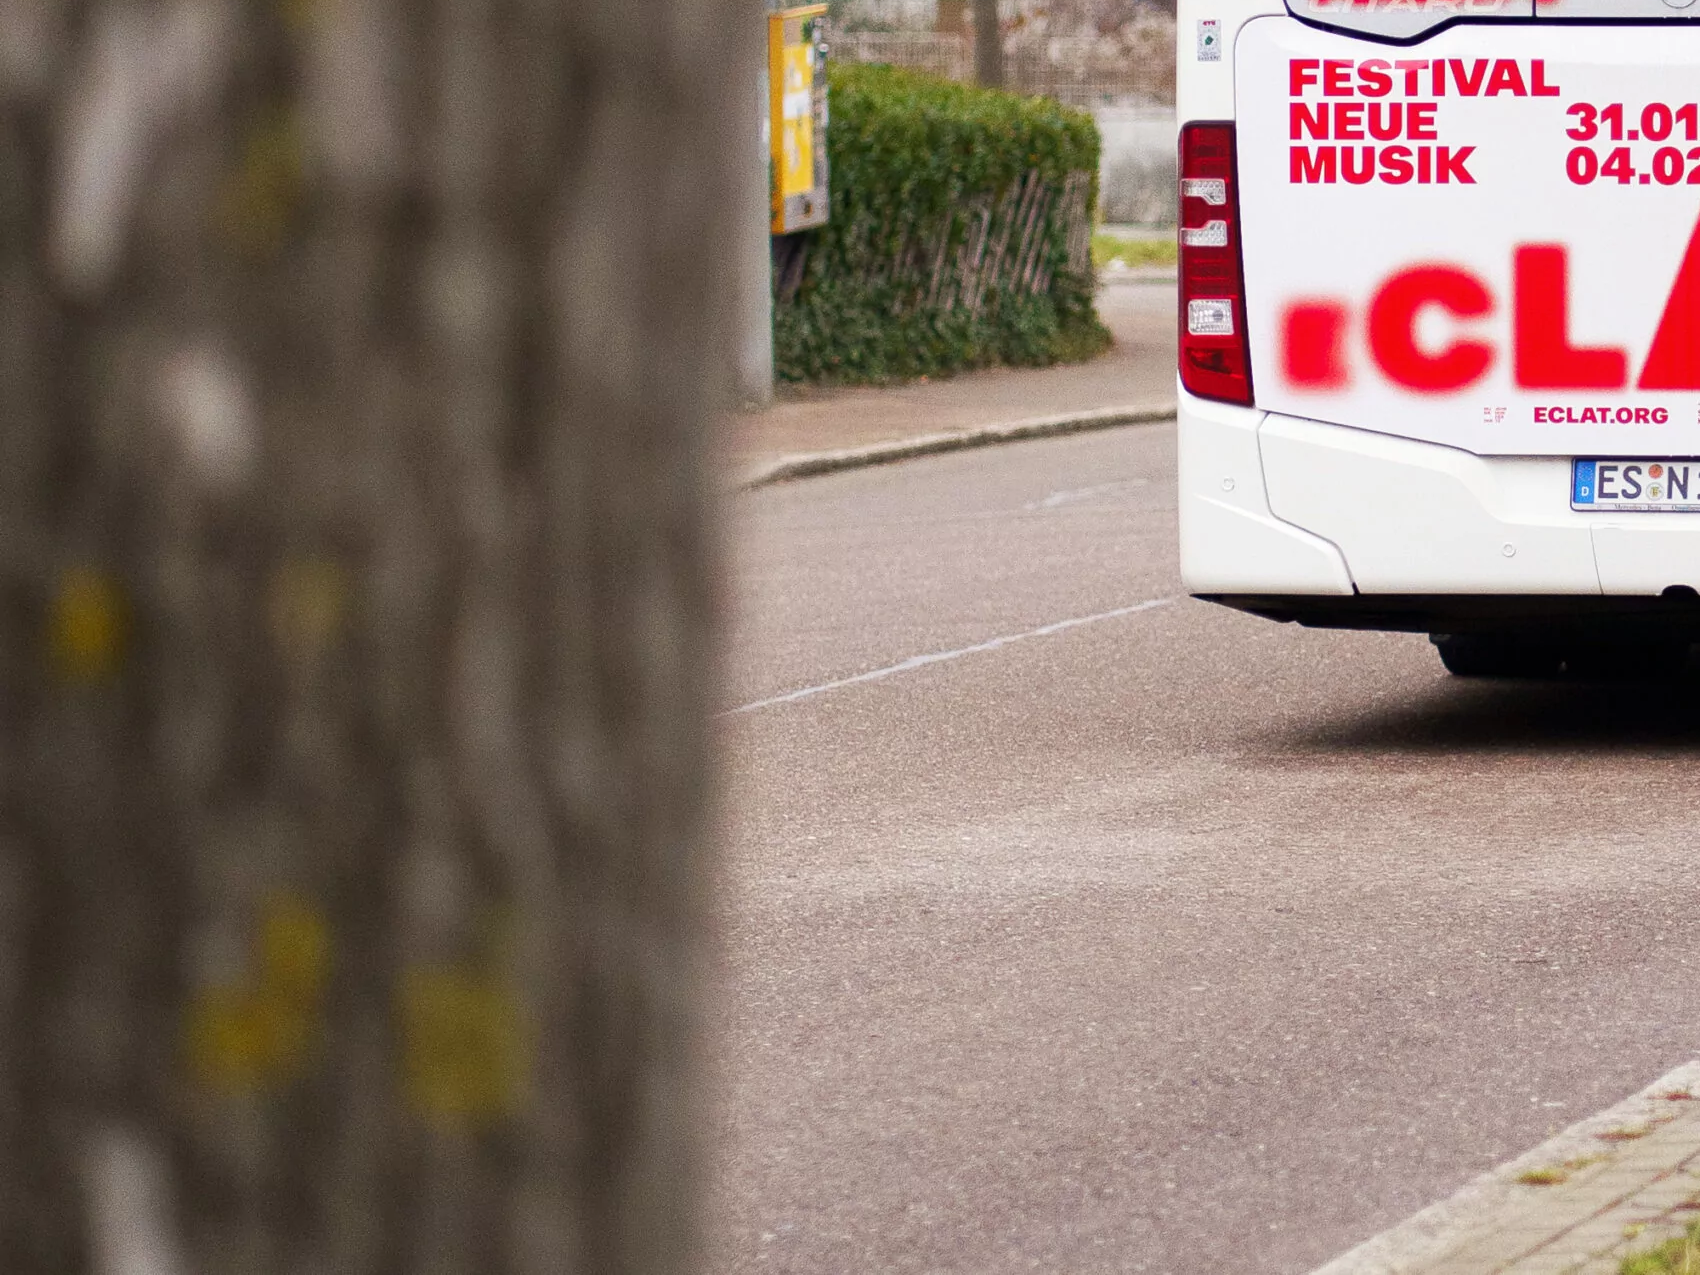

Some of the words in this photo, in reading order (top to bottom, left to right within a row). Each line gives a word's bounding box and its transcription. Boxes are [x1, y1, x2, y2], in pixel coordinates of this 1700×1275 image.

[1289, 58, 1561, 97] FESTIVAL
[1289, 102, 1438, 140] NEUE
[1289, 145, 1478, 184] MUSIK
[1534, 406, 1669, 424] ECLAT.ORG
[1581, 486, 1589, 497] D
[1598, 465, 1643, 500] ES
[1667, 466, 1690, 500] N
